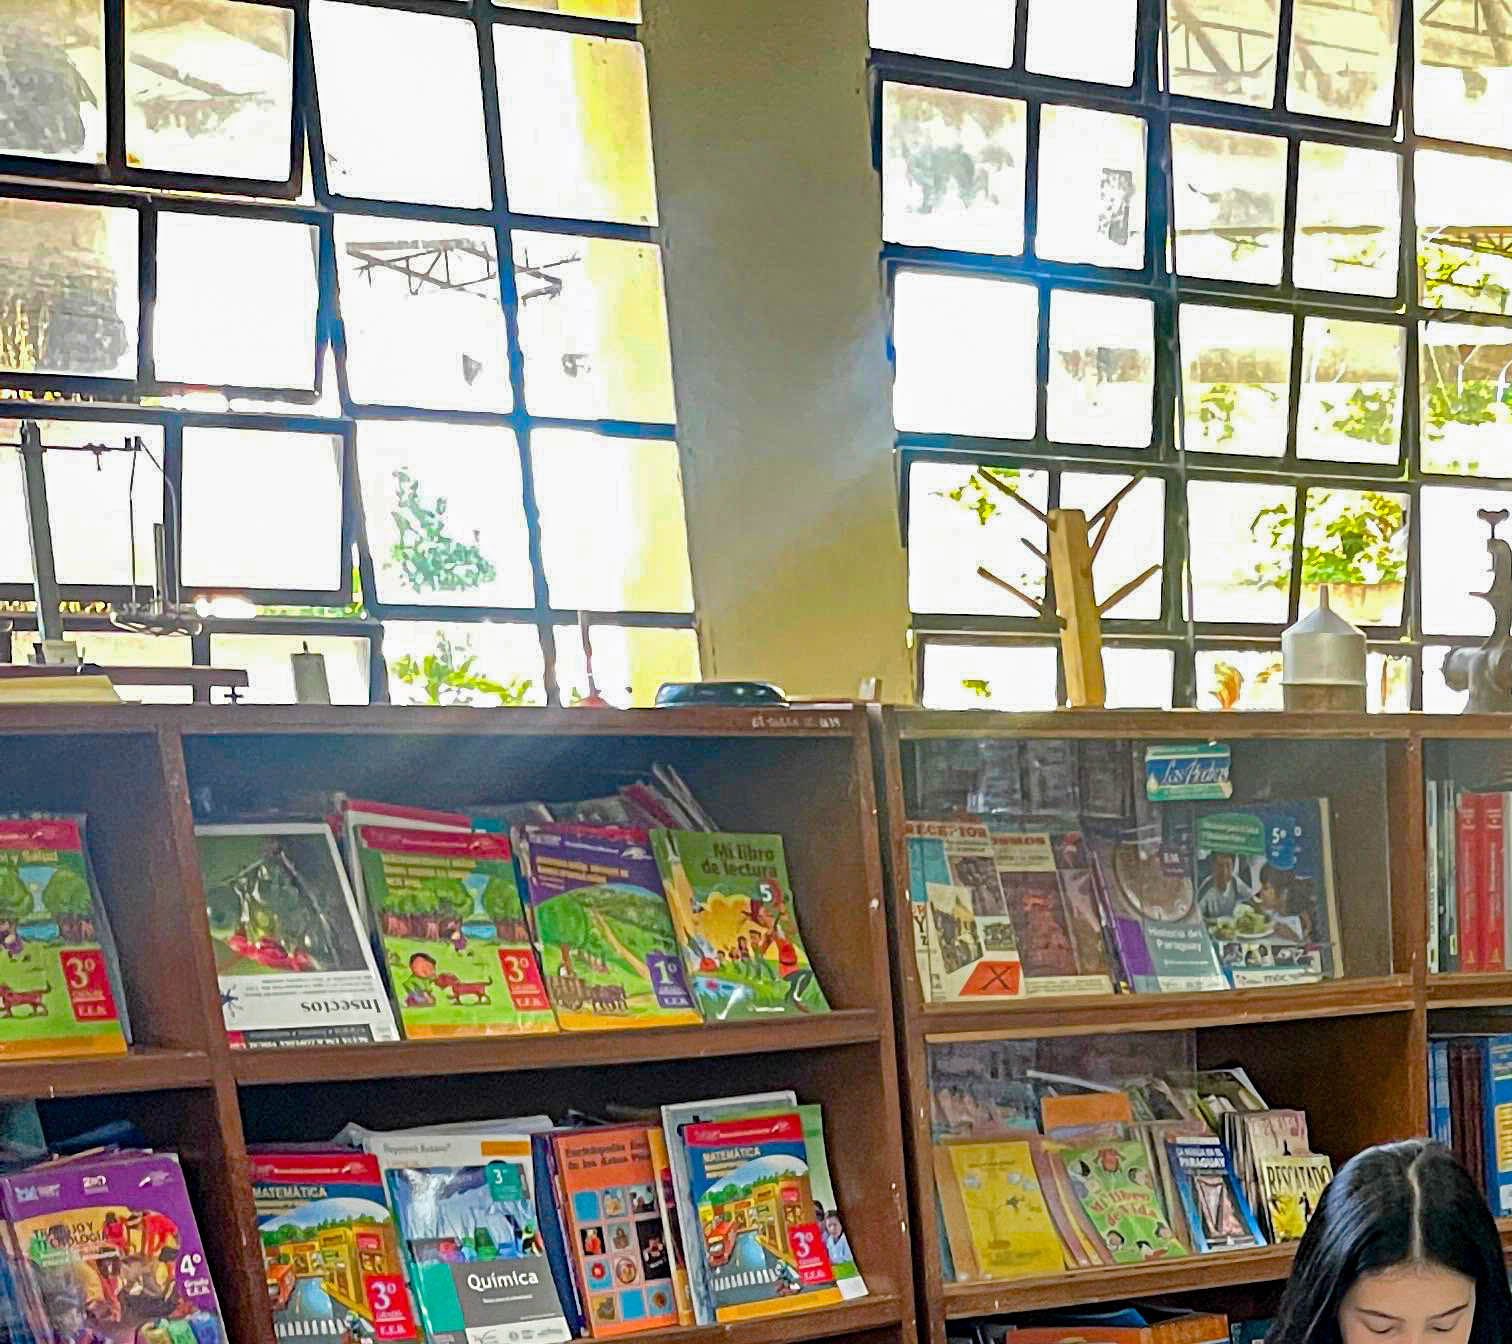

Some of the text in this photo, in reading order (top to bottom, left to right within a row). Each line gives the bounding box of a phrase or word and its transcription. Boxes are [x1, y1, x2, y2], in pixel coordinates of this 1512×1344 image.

[759, 884, 773, 903] 5
[300, 999, 382, 1014] Insectos
[467, 1270, 539, 1292] Química
